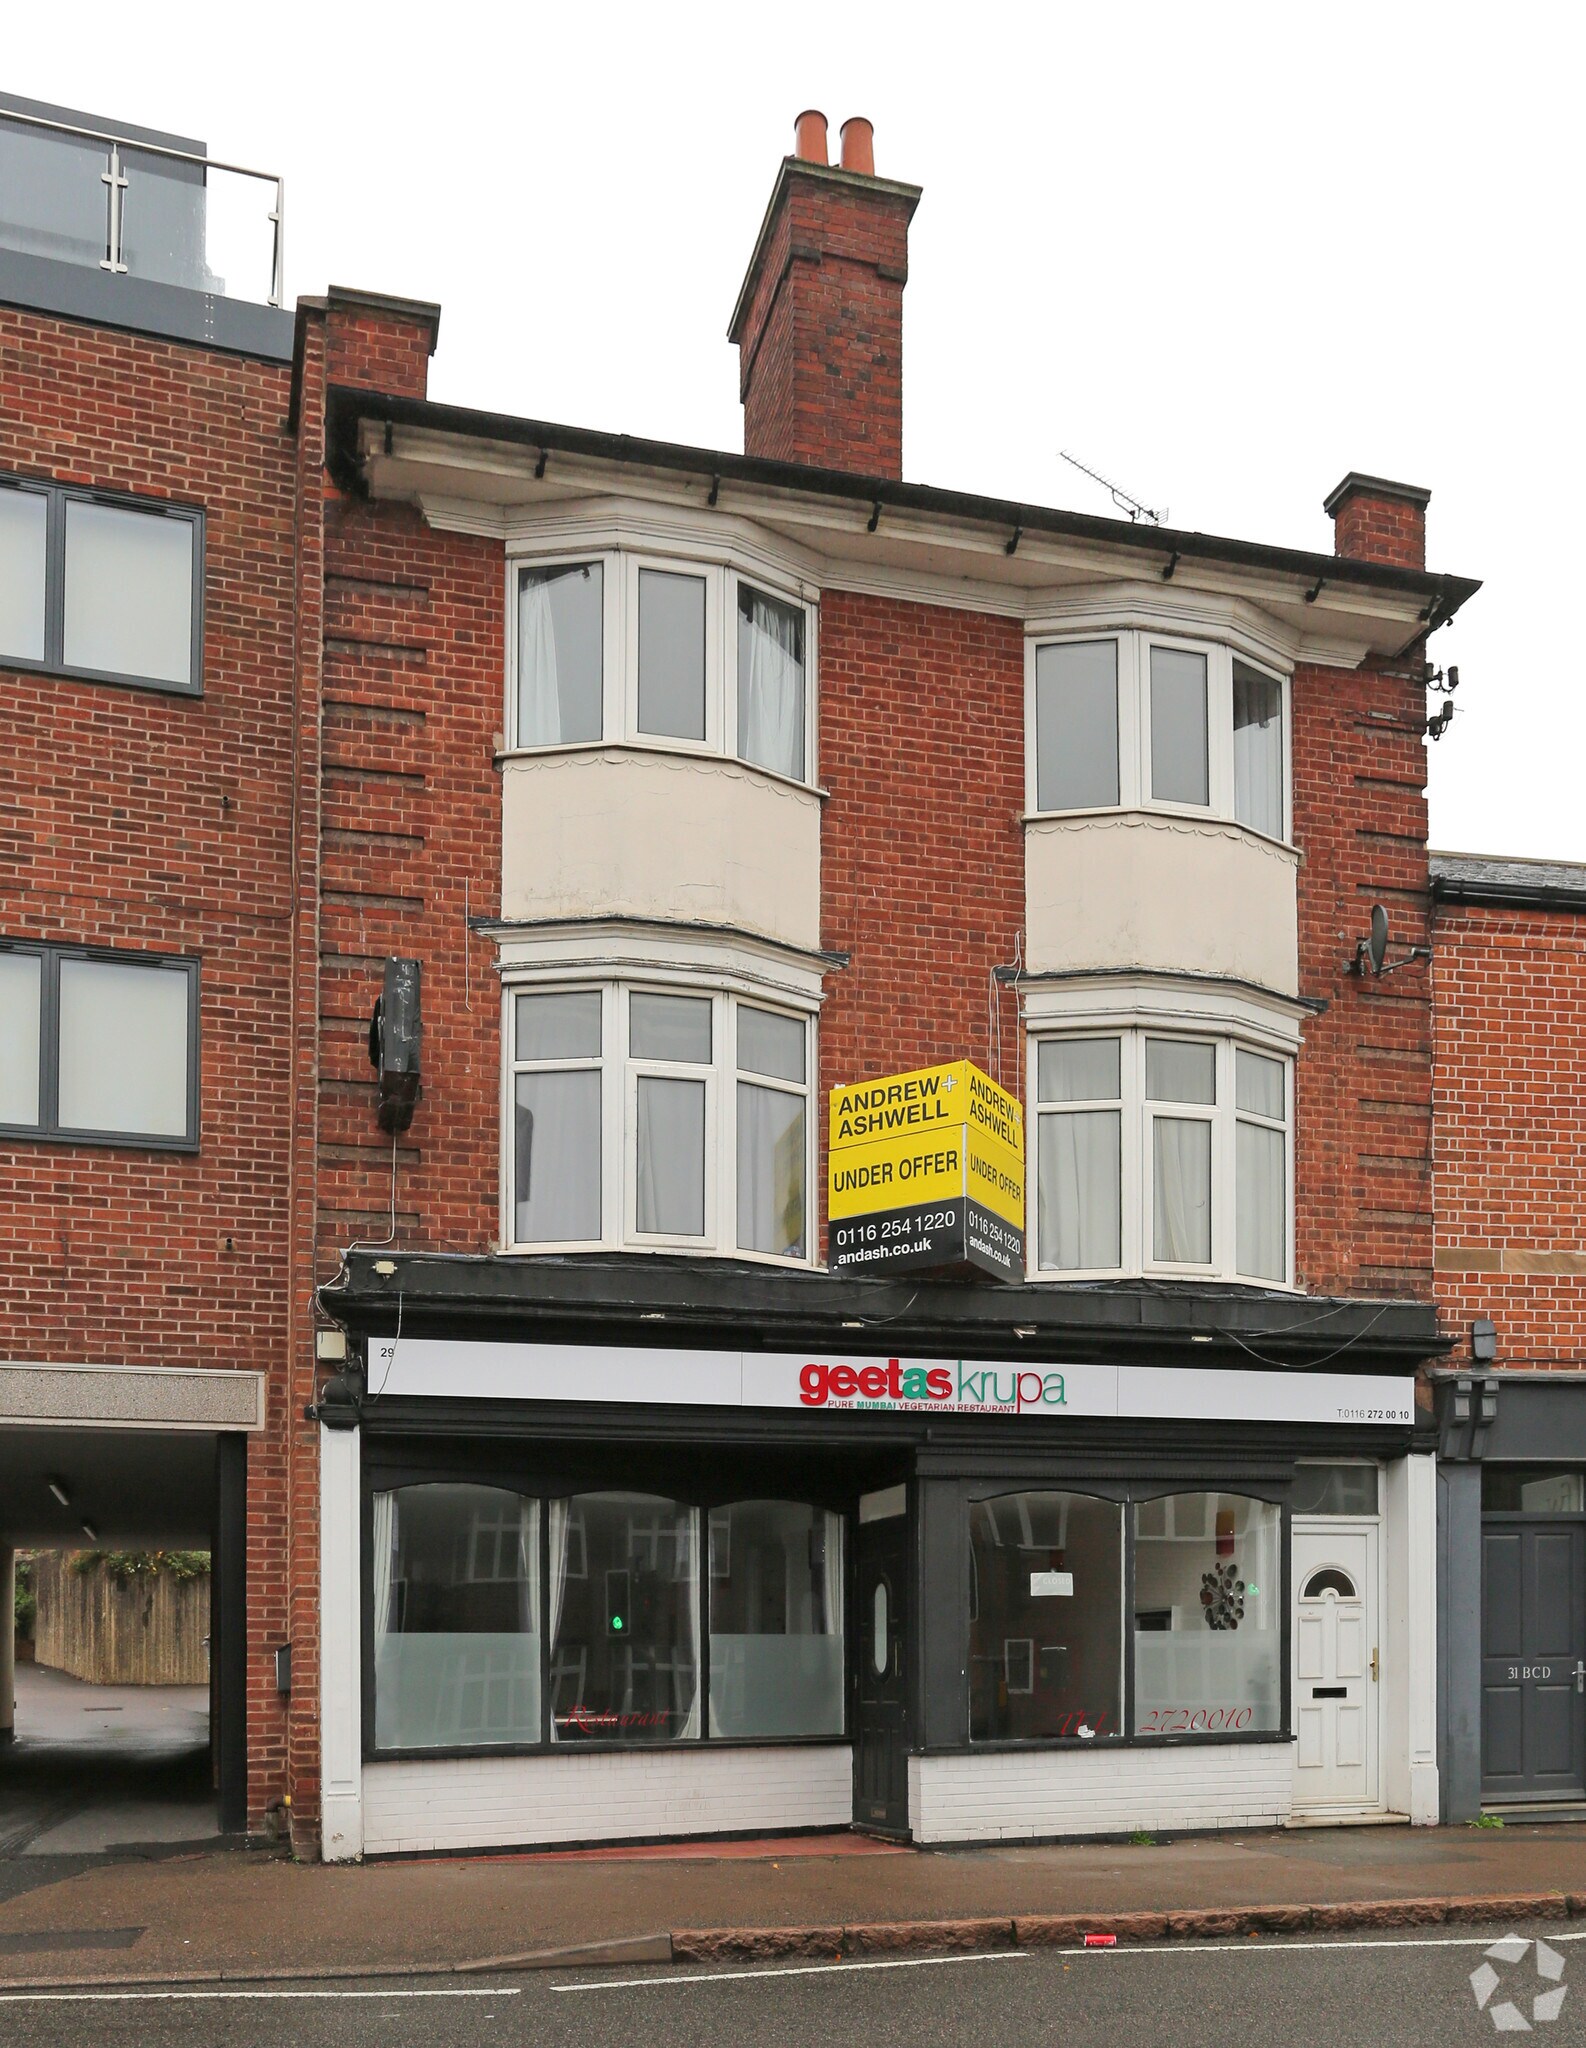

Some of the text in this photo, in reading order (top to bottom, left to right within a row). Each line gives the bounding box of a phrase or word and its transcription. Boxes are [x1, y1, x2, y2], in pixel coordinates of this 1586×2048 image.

[838, 1099, 949, 1140] ASHWELL
[969, 1102, 1018, 1149] ASHWELL
[834, 1150, 958, 1192] UNDER OFFER
[970, 1153, 1021, 1203] UNDER OFFER
[837, 1210, 956, 1246] 0116 254 1220
[969, 1210, 1021, 1255] 0116 254 1220
[838, 1238, 932, 1265] andash.co.uk
[969, 1235, 1012, 1268] andash.co.uk
[380, 1347, 394, 1358] 29
[828, 1400, 1015, 1413] PURE MUMBAI VEGETARIAN RESTAURANT
[1367, 1409, 1383, 1419] 272
[1385, 1410, 1396, 1419] 00
[1399, 1411, 1409, 1419] 10
[1508, 1666, 1551, 1679] 31 BCD
[1139, 1707, 1253, 1732] 2720010
